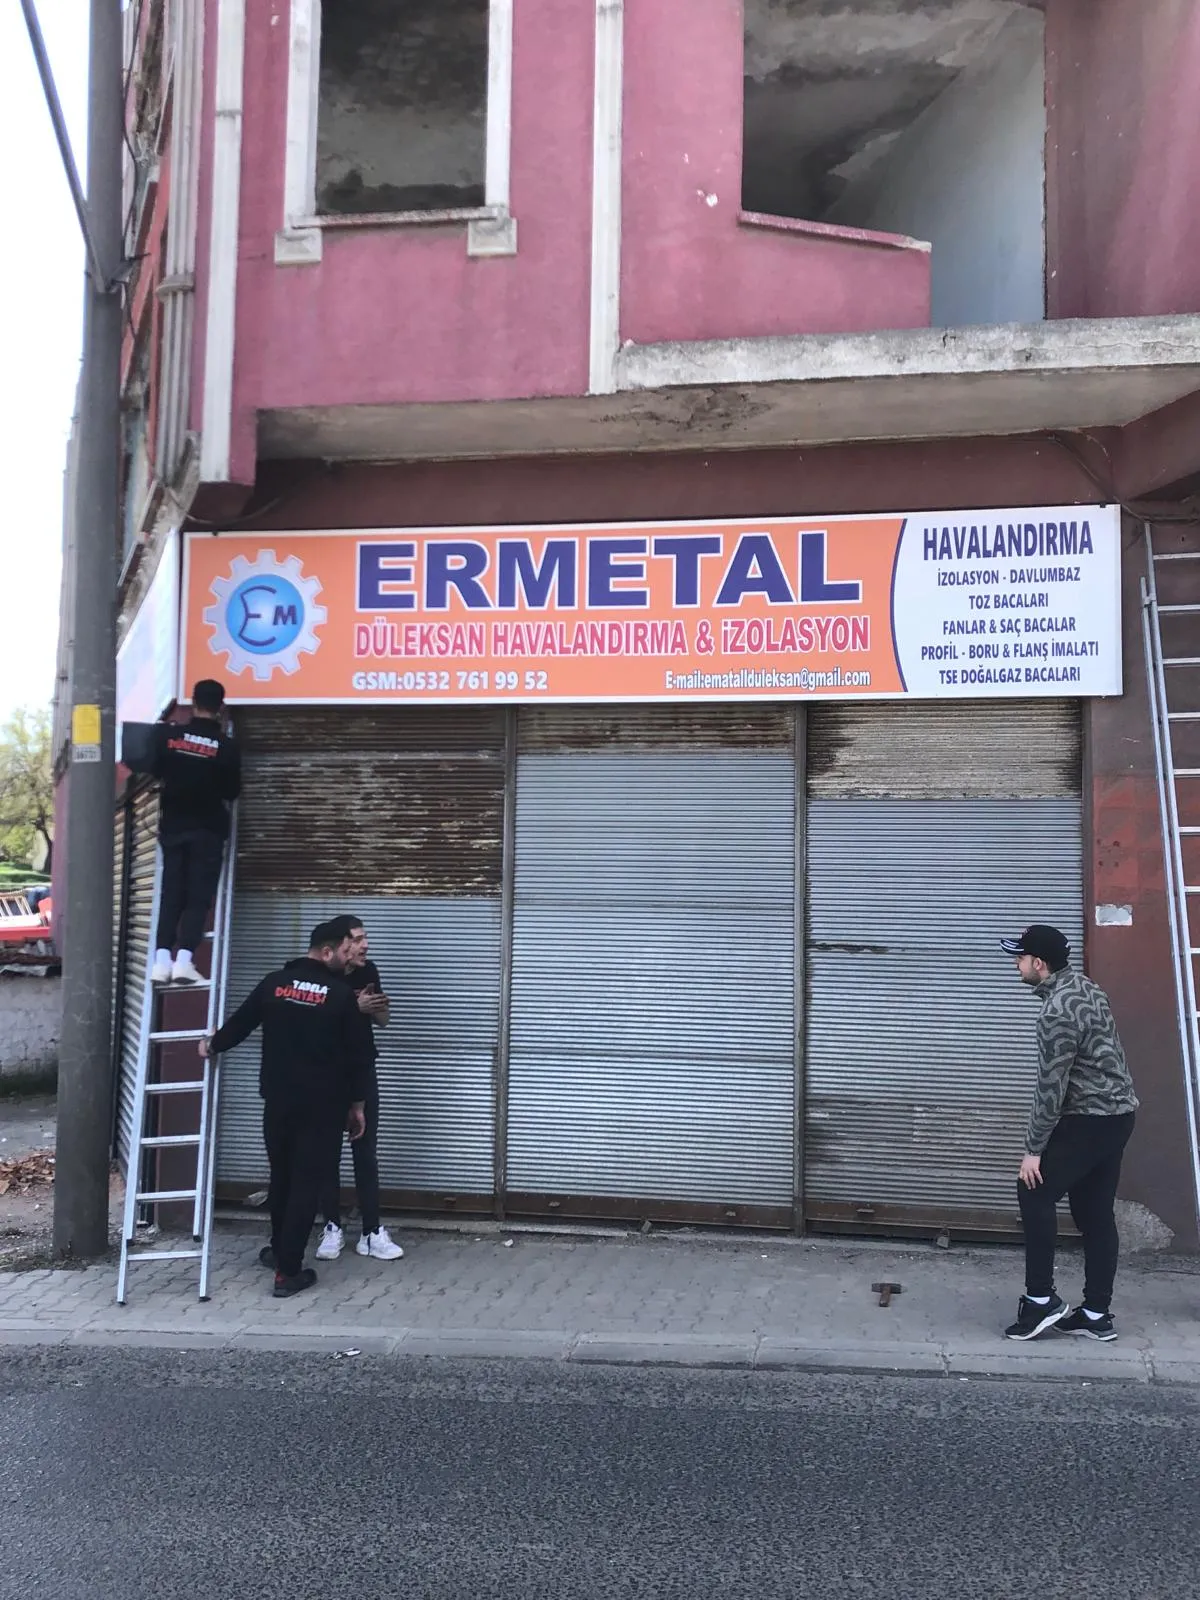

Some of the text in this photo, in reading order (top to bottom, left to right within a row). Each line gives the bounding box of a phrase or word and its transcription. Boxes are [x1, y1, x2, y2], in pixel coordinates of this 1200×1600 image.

[923, 521, 1094, 561] HAVALANDIRMA
[356, 530, 863, 611] ERMETAL
[937, 568, 999, 586] İZOLASYON
[1010, 567, 1081, 584] DAVLUMBAZ
[969, 593, 1049, 609] TOZ BACALARI
[354, 616, 486, 658] DÜLEKSAN
[491, 620, 689, 657] HAVALANDIRMA
[696, 619, 715, 656] &
[943, 617, 1076, 637] FANLAR & SAÇ BACALAR
[921, 642, 959, 660] PROFİL
[969, 644, 999, 658] BORU
[1002, 643, 1010, 658] &
[1013, 642, 1048, 661] FLANŞ
[1051, 638, 1099, 656] İMALATI
[352, 671, 548, 690] GSM:0532 761 99 52
[939, 664, 1081, 684] TSE DOĞALGAZ BACALARI
